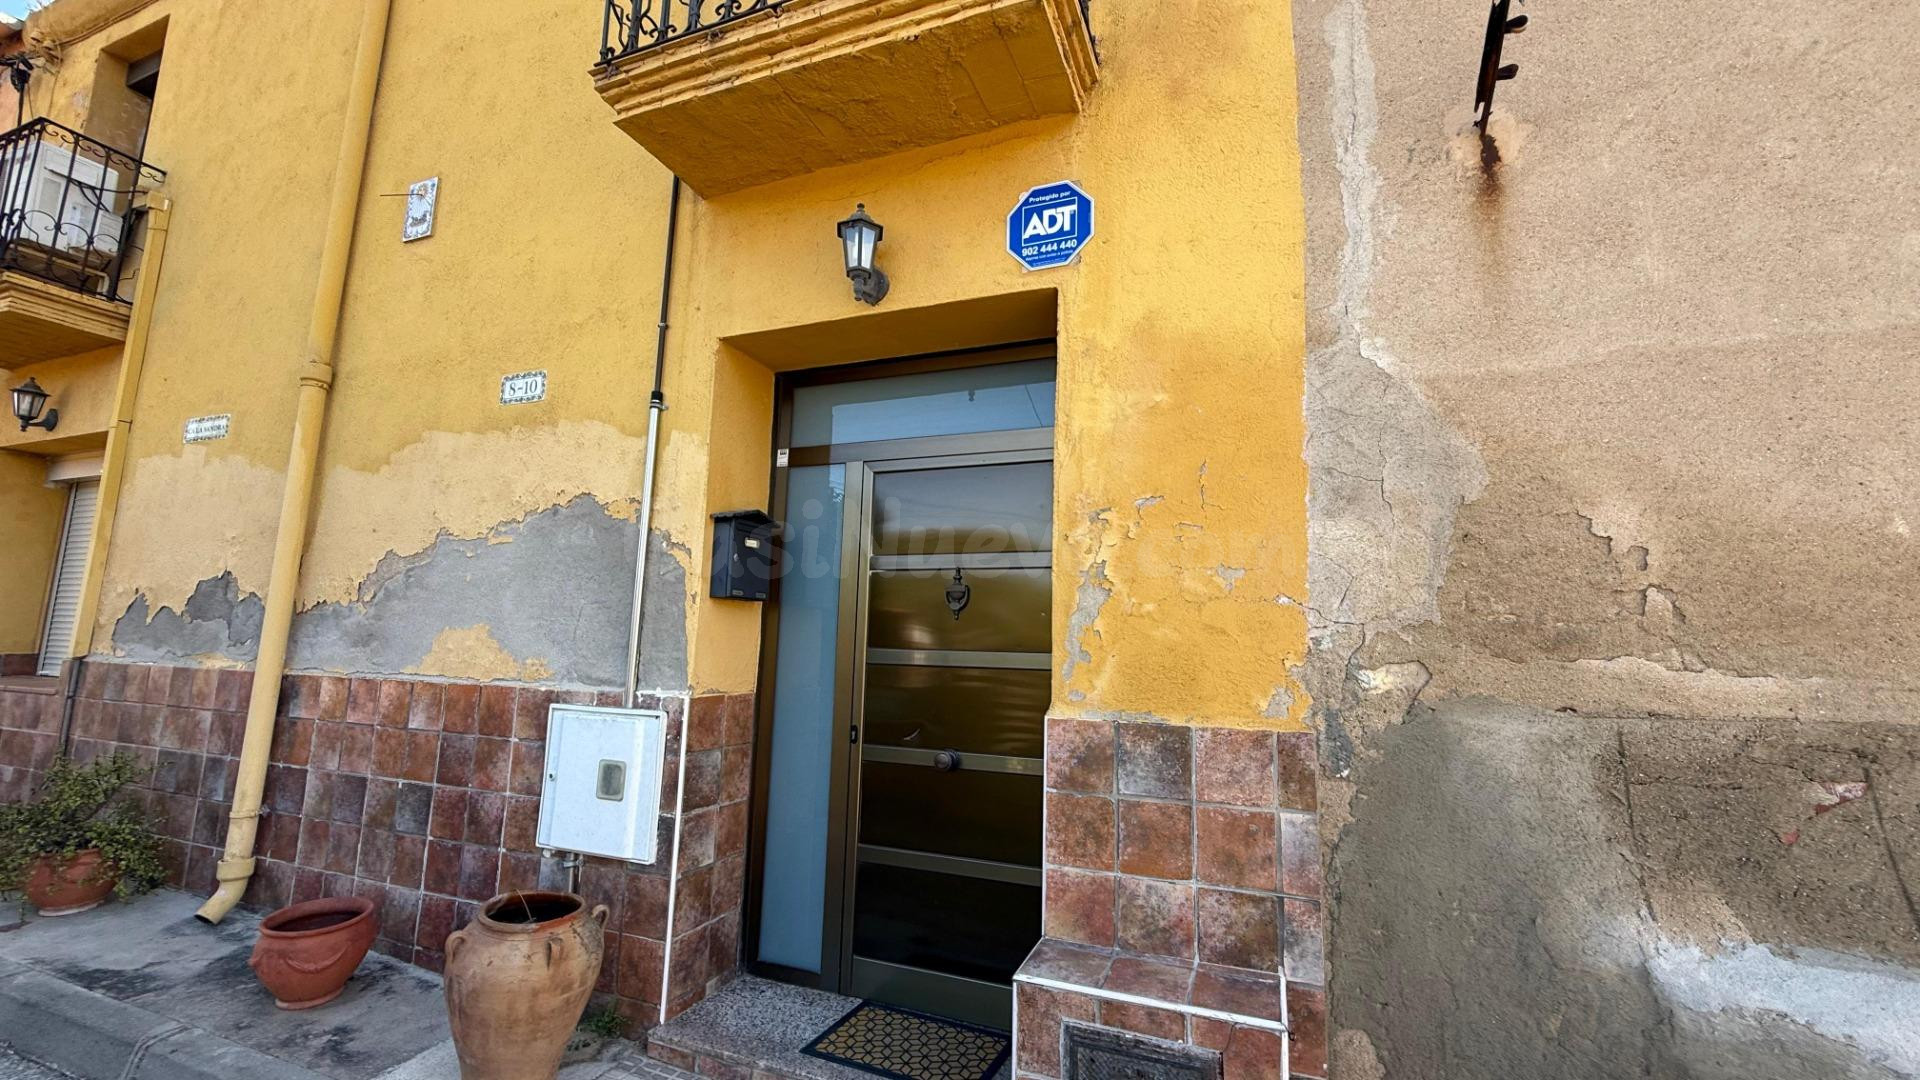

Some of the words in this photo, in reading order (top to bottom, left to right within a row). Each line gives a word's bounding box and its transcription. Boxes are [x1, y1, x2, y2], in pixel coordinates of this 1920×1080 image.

[1028, 193, 1059, 203] Protegido
[1060, 190, 1071, 198] por
[1023, 204, 1077, 239] ADT
[1022, 246, 1039, 257] 902
[1040, 242, 1058, 253] 444
[1060, 239, 1077, 250] 440
[508, 379, 538, 397] 8-10
